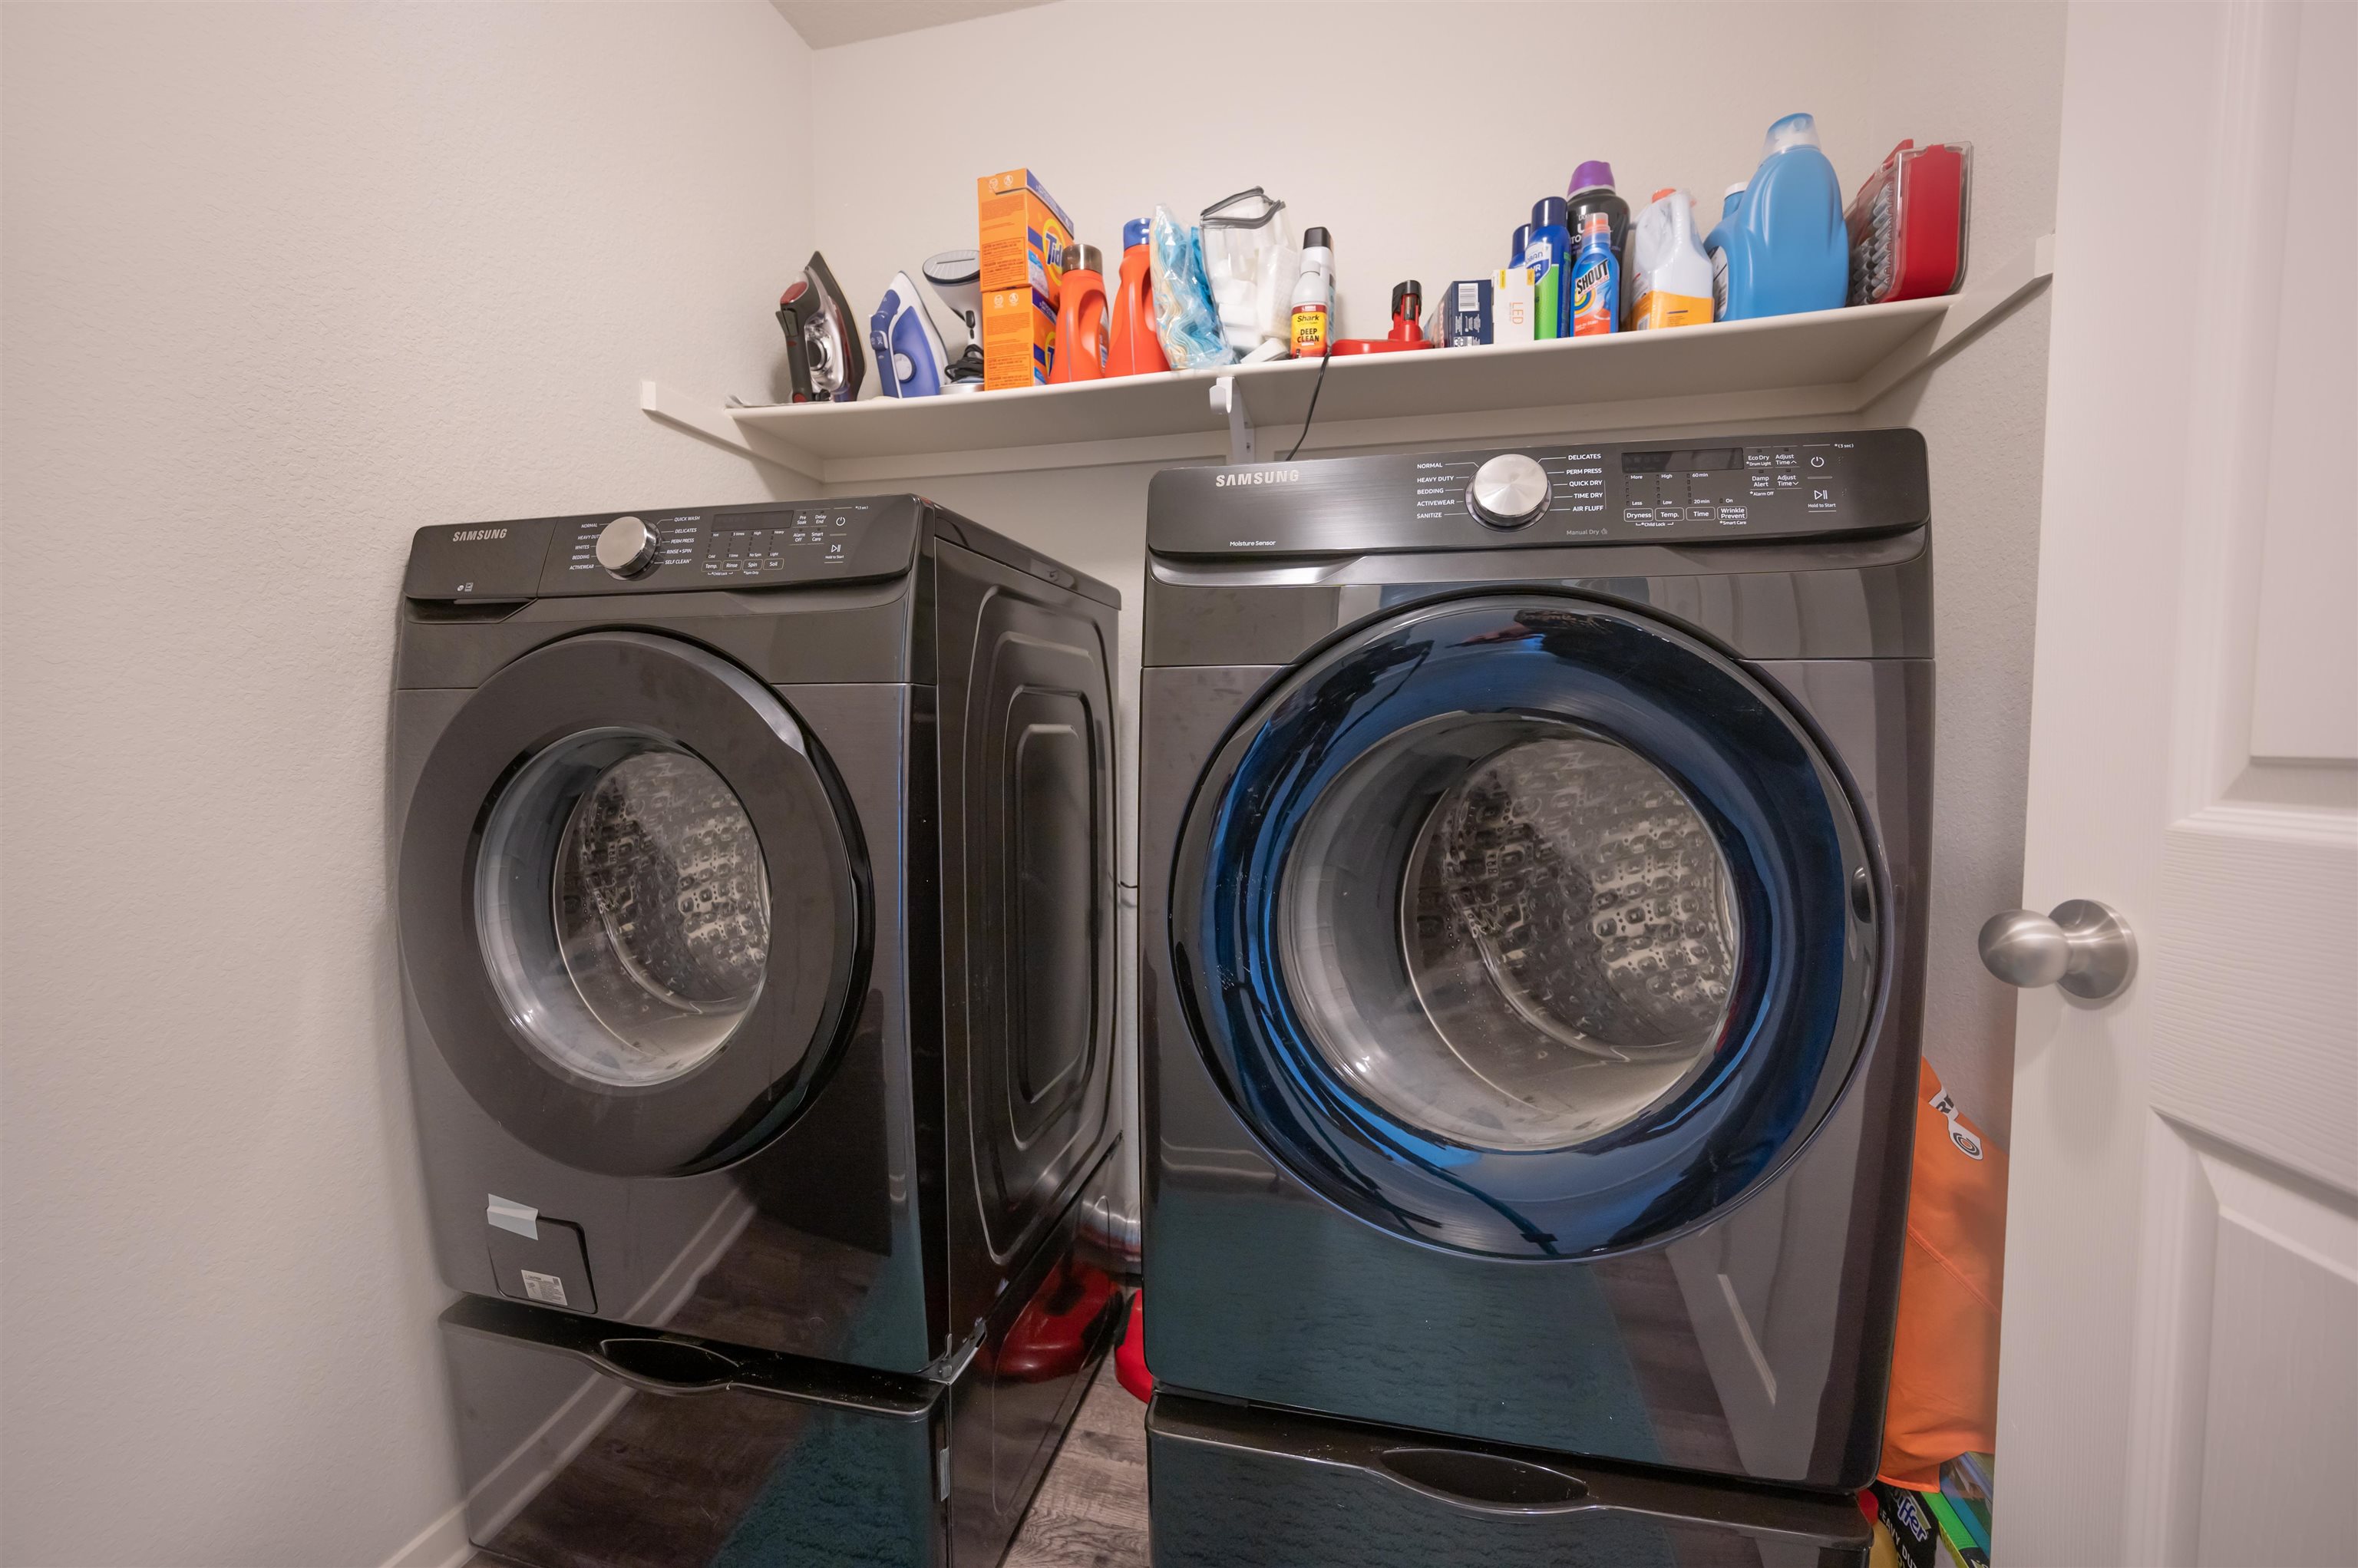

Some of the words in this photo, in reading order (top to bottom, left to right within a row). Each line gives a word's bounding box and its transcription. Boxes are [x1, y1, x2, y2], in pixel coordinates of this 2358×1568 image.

[1045, 233, 1062, 267] Tid
[1577, 259, 1608, 294] SHOUT
[1512, 302, 1524, 325] LED
[1215, 470, 1300, 487] SAMSUNG
[453, 529, 507, 542] SAMSUNG
[1881, 1510, 1901, 1546] EAVY
